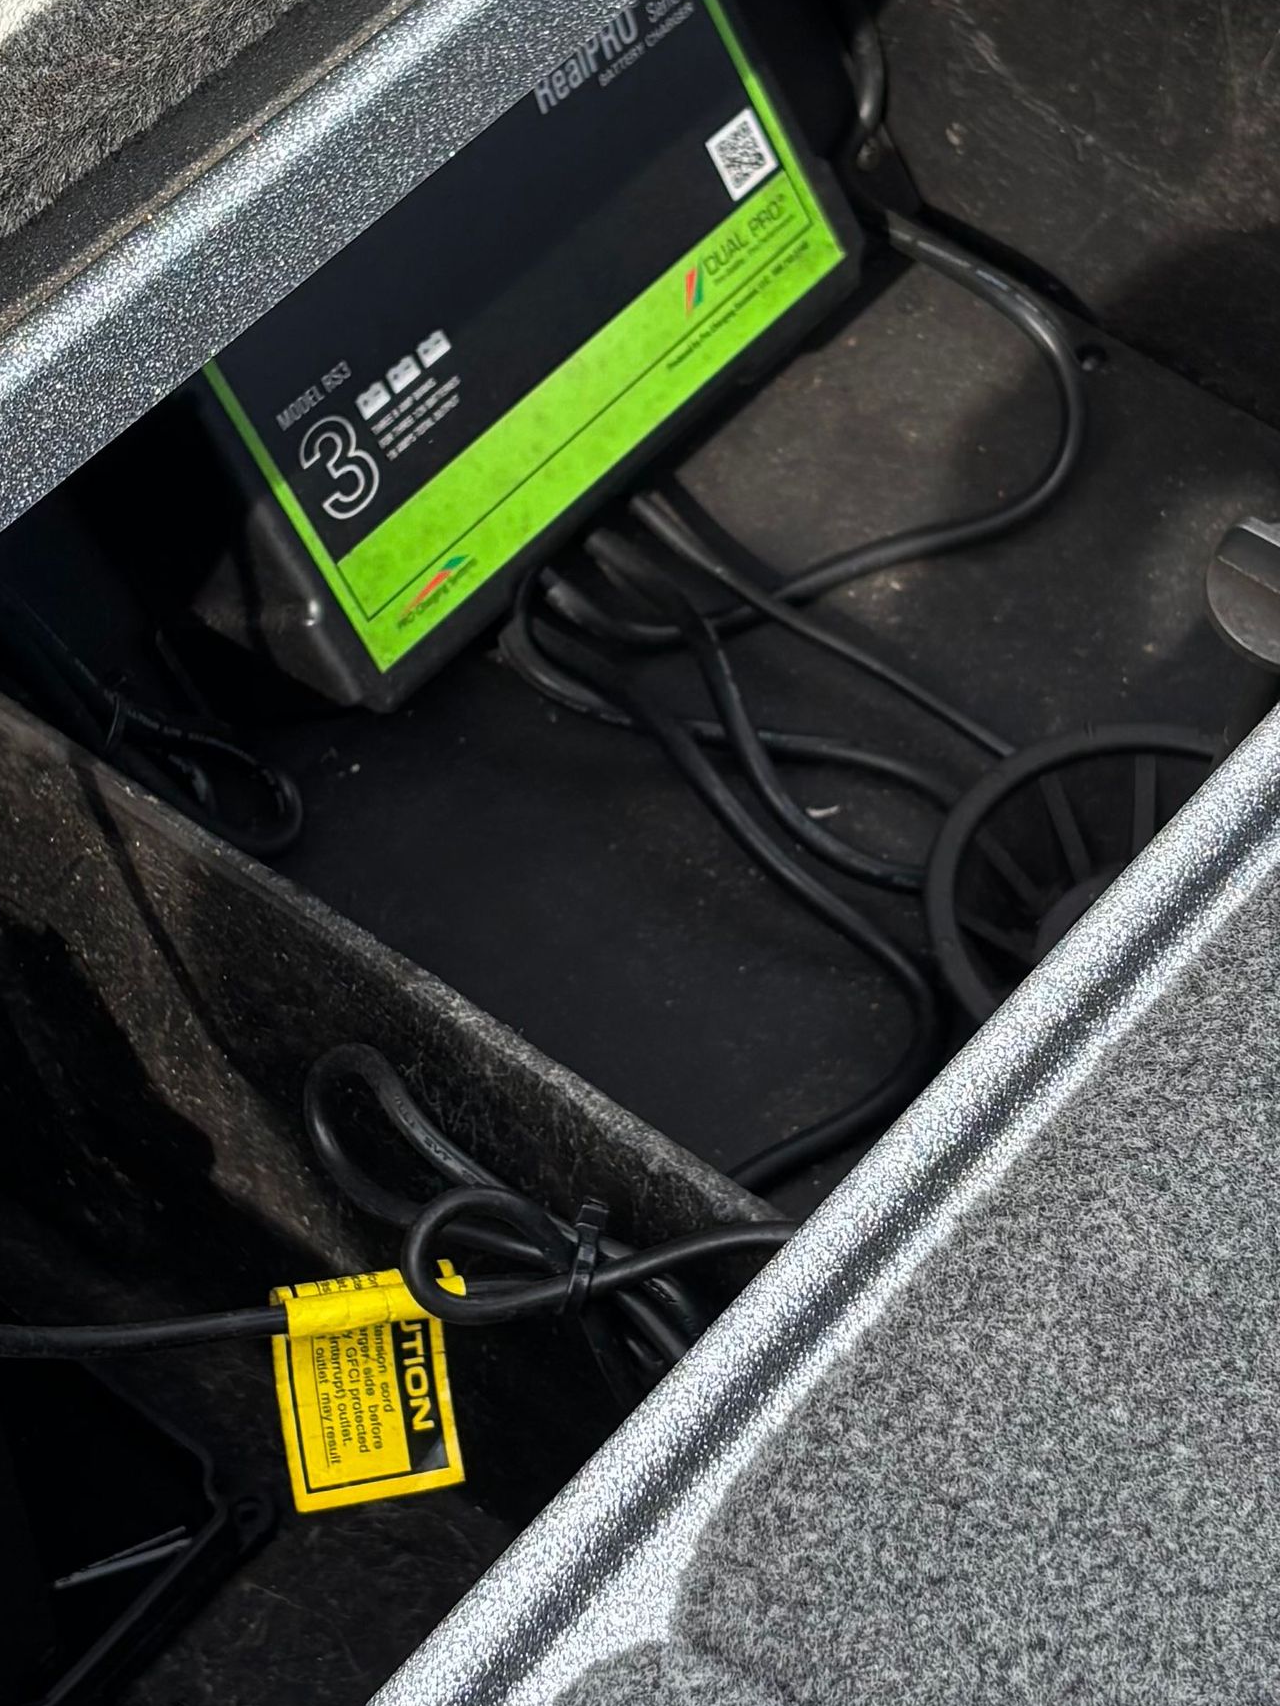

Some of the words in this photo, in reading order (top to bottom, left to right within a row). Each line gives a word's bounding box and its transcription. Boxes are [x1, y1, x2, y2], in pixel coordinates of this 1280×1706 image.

[276, 385, 324, 430] MODEL
[300, 416, 379, 519] 3
[314, 1346, 328, 1383] outlet
[344, 1346, 360, 1383] GFCI
[362, 1366, 376, 1396] side
[316, 1391, 332, 1423] may
[379, 1381, 395, 1412] cord
[336, 1402, 352, 1446] outlet.
[347, 1387, 370, 1453] protected
[367, 1403, 382, 1449] before
[325, 1425, 341, 1464] result
